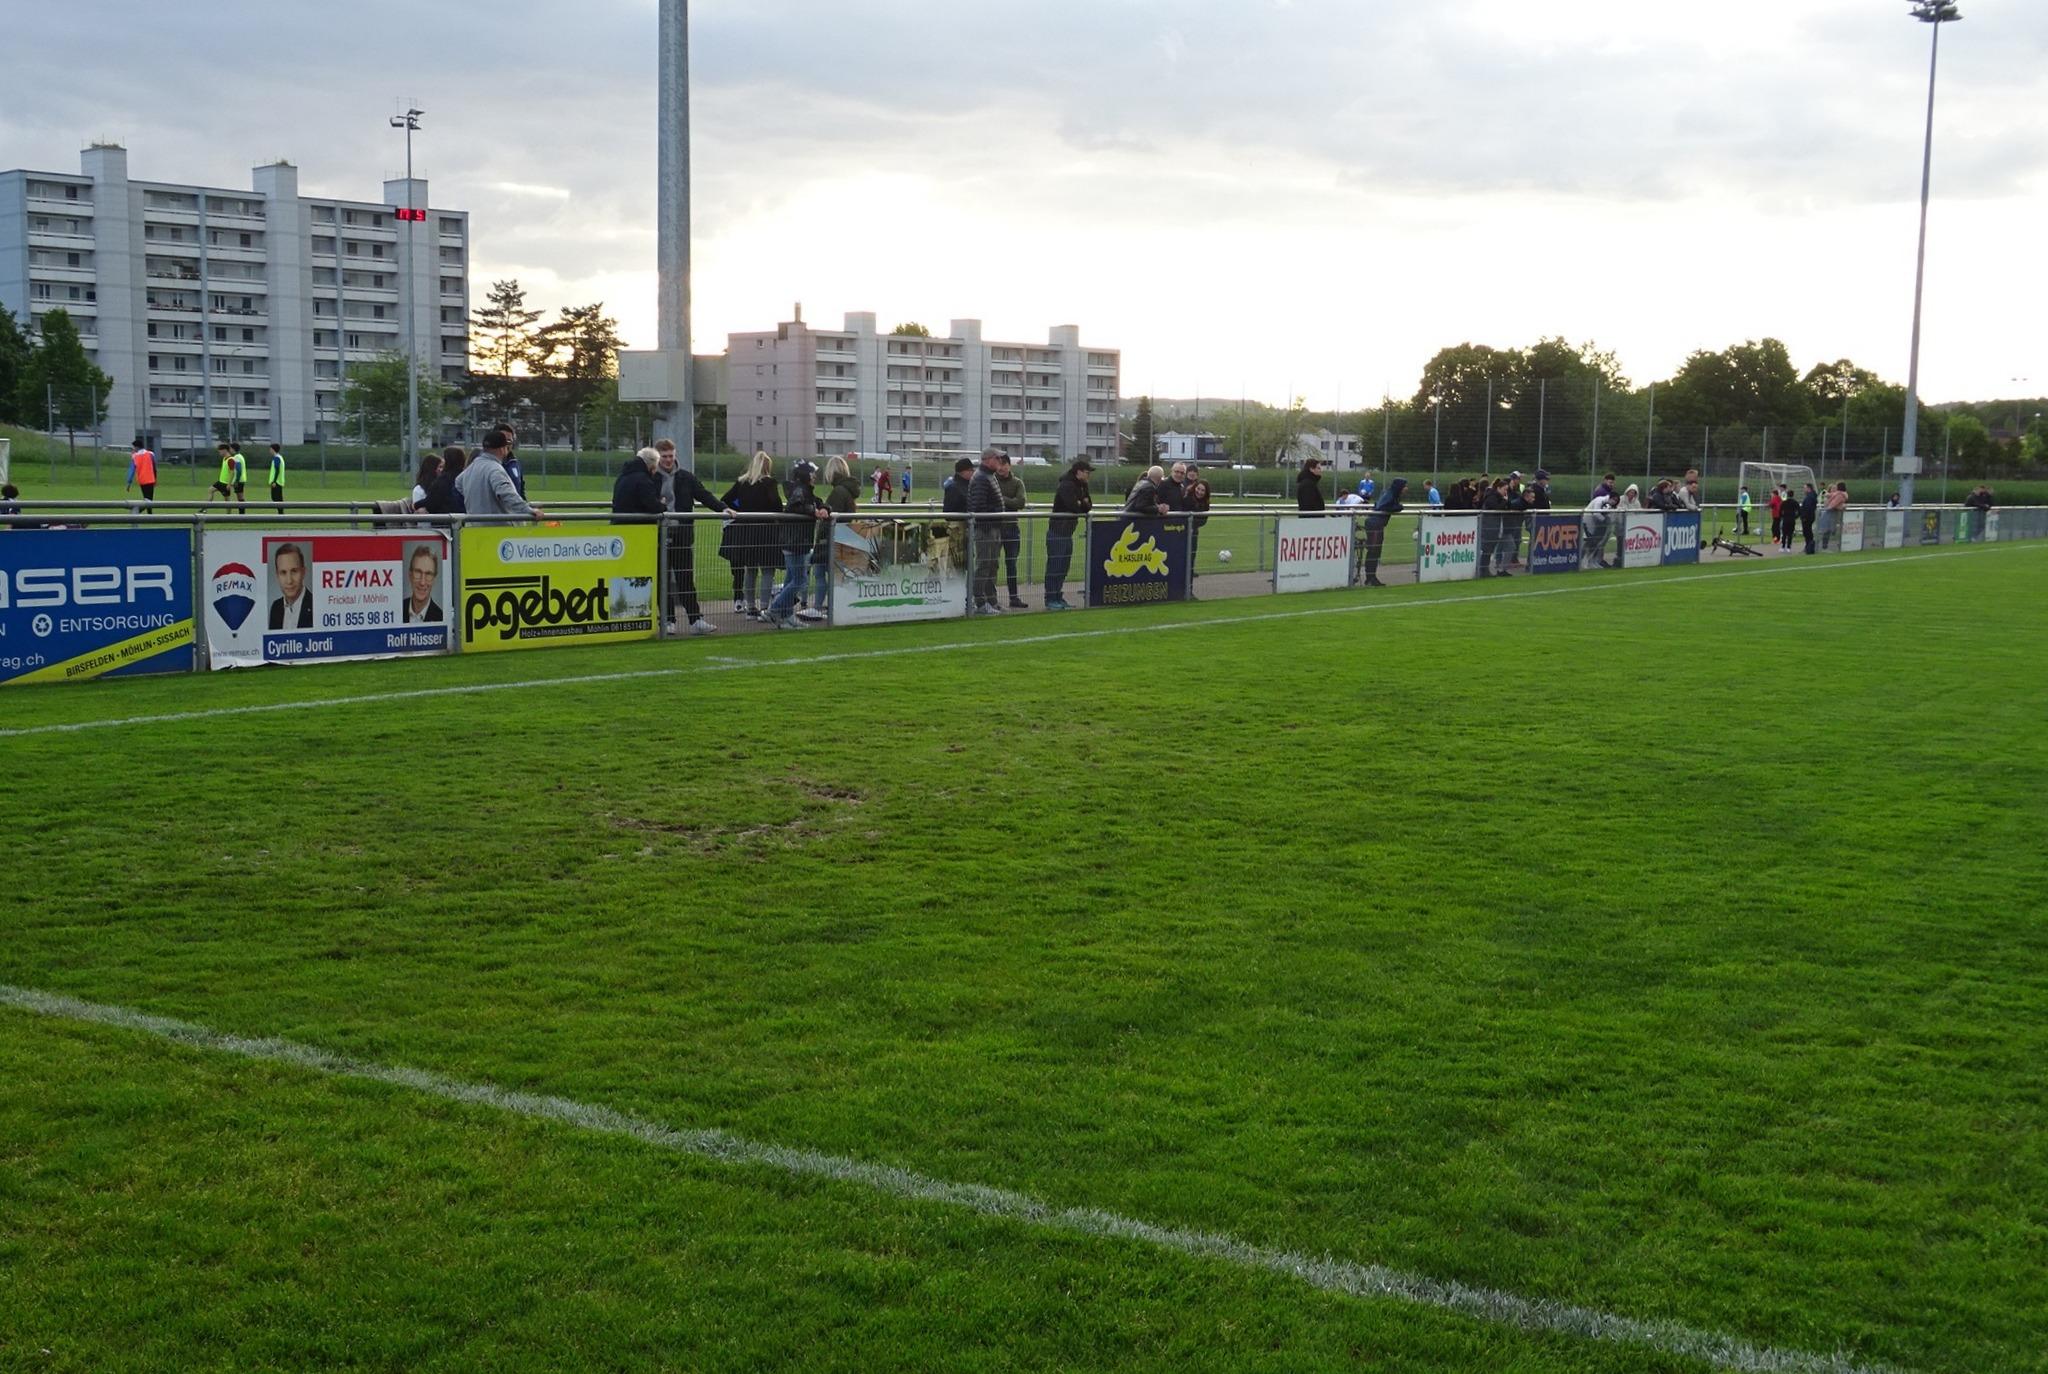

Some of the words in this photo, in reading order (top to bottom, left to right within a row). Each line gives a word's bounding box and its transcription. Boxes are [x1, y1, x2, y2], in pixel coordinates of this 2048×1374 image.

[1437, 531, 1475, 546] oberdorf
[517, 543, 550, 558] Vielen
[553, 543, 580, 557] Dank
[583, 542, 607, 556] Gebi
[1280, 535, 1348, 562] RAIFFEISEN
[216, 580, 253, 594] RE/MAX
[322, 568, 394, 589] RE/MAX
[857, 580, 897, 598] Traum
[901, 579, 942, 595] Garten
[328, 594, 357, 605] Fricktal
[363, 593, 389, 604] Möhlin
[60, 613, 174, 633] ENTSORGUNG
[323, 613, 341, 627] 061
[345, 612, 365, 626] 855
[368, 611, 381, 625] 98
[383, 610, 394, 624] 81
[268, 638, 303, 655] Cyrille
[305, 637, 333, 652] Jordi
[387, 633, 407, 647] Rolf
[409, 632, 443, 646] Hüsser
[66, 652, 115, 677] BIRSFELDEN
[156, 626, 190, 646] SISSACH
[0, 652, 44, 669] ag.ch
